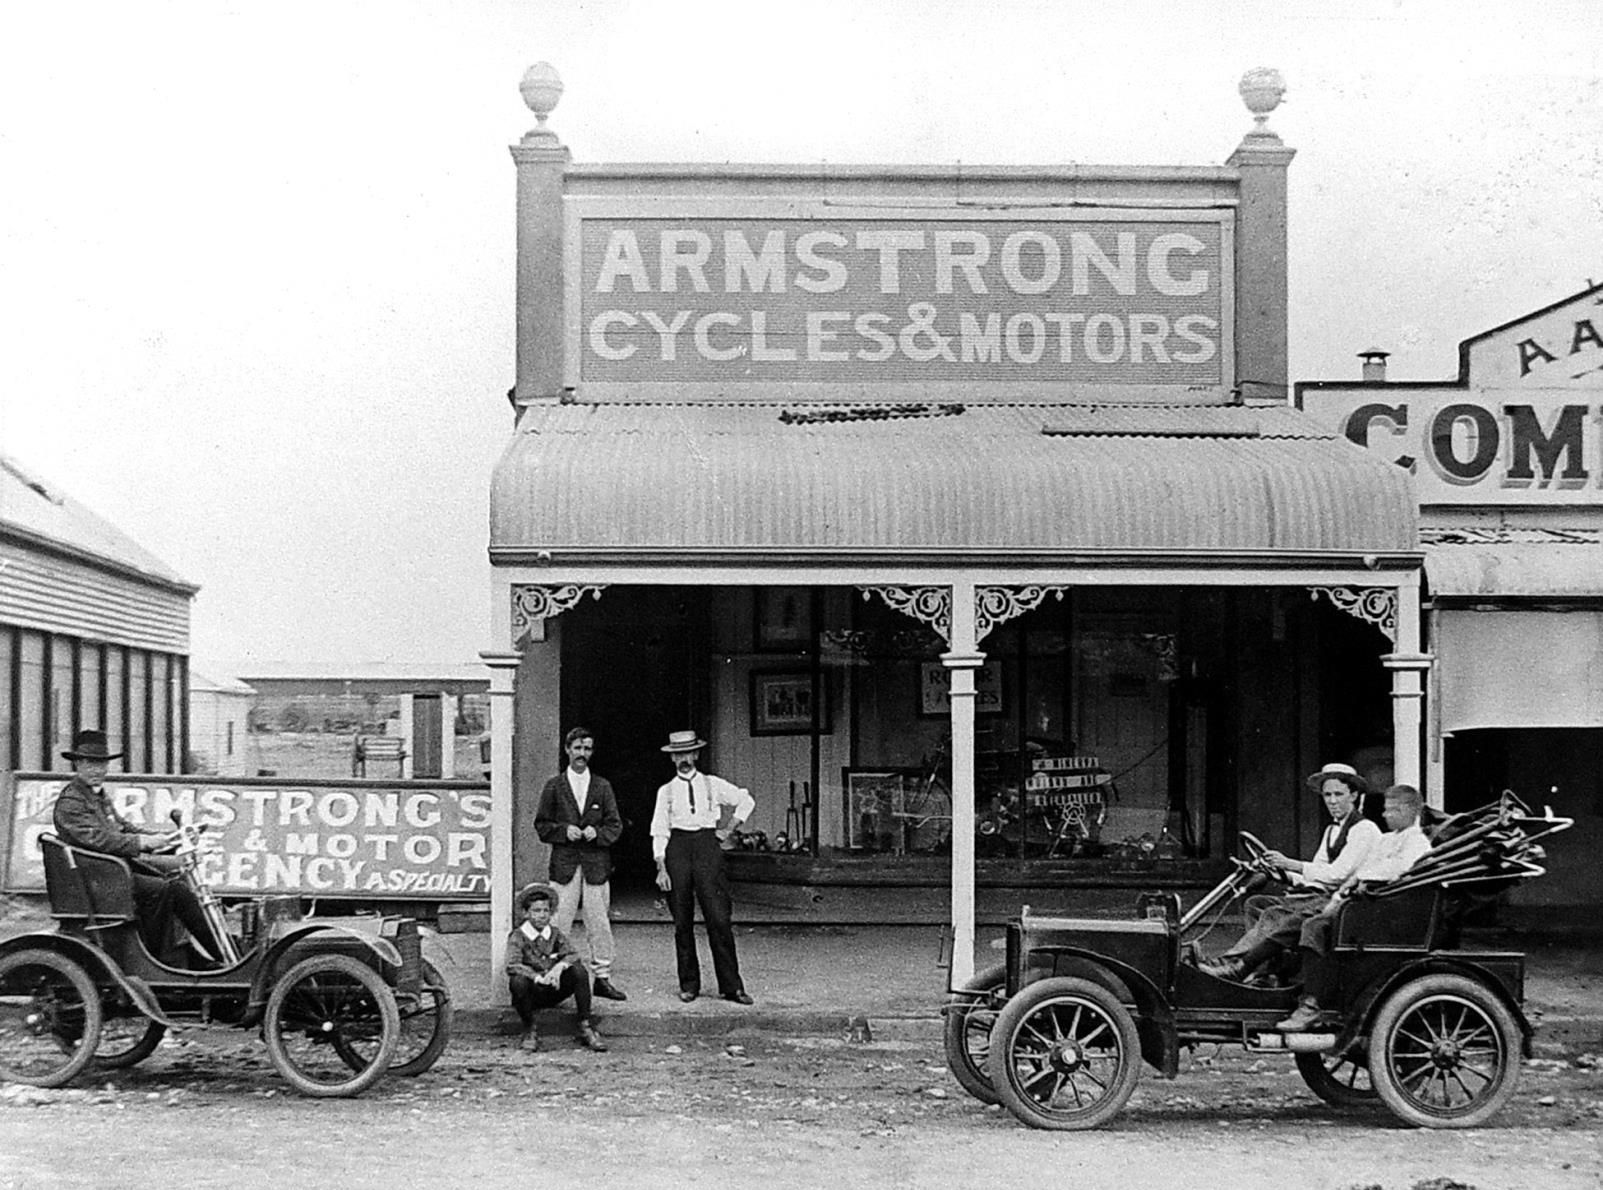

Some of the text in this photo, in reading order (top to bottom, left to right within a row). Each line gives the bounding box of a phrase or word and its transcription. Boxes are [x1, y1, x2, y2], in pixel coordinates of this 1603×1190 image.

[595, 229, 1211, 297] ARMSTRONG
[1342, 403, 1603, 484] COM
[113, 786, 492, 829] RMSTRONG'S
[244, 829, 267, 851] &
[286, 832, 487, 868] MOTOR
[198, 852, 366, 889] GENCY
